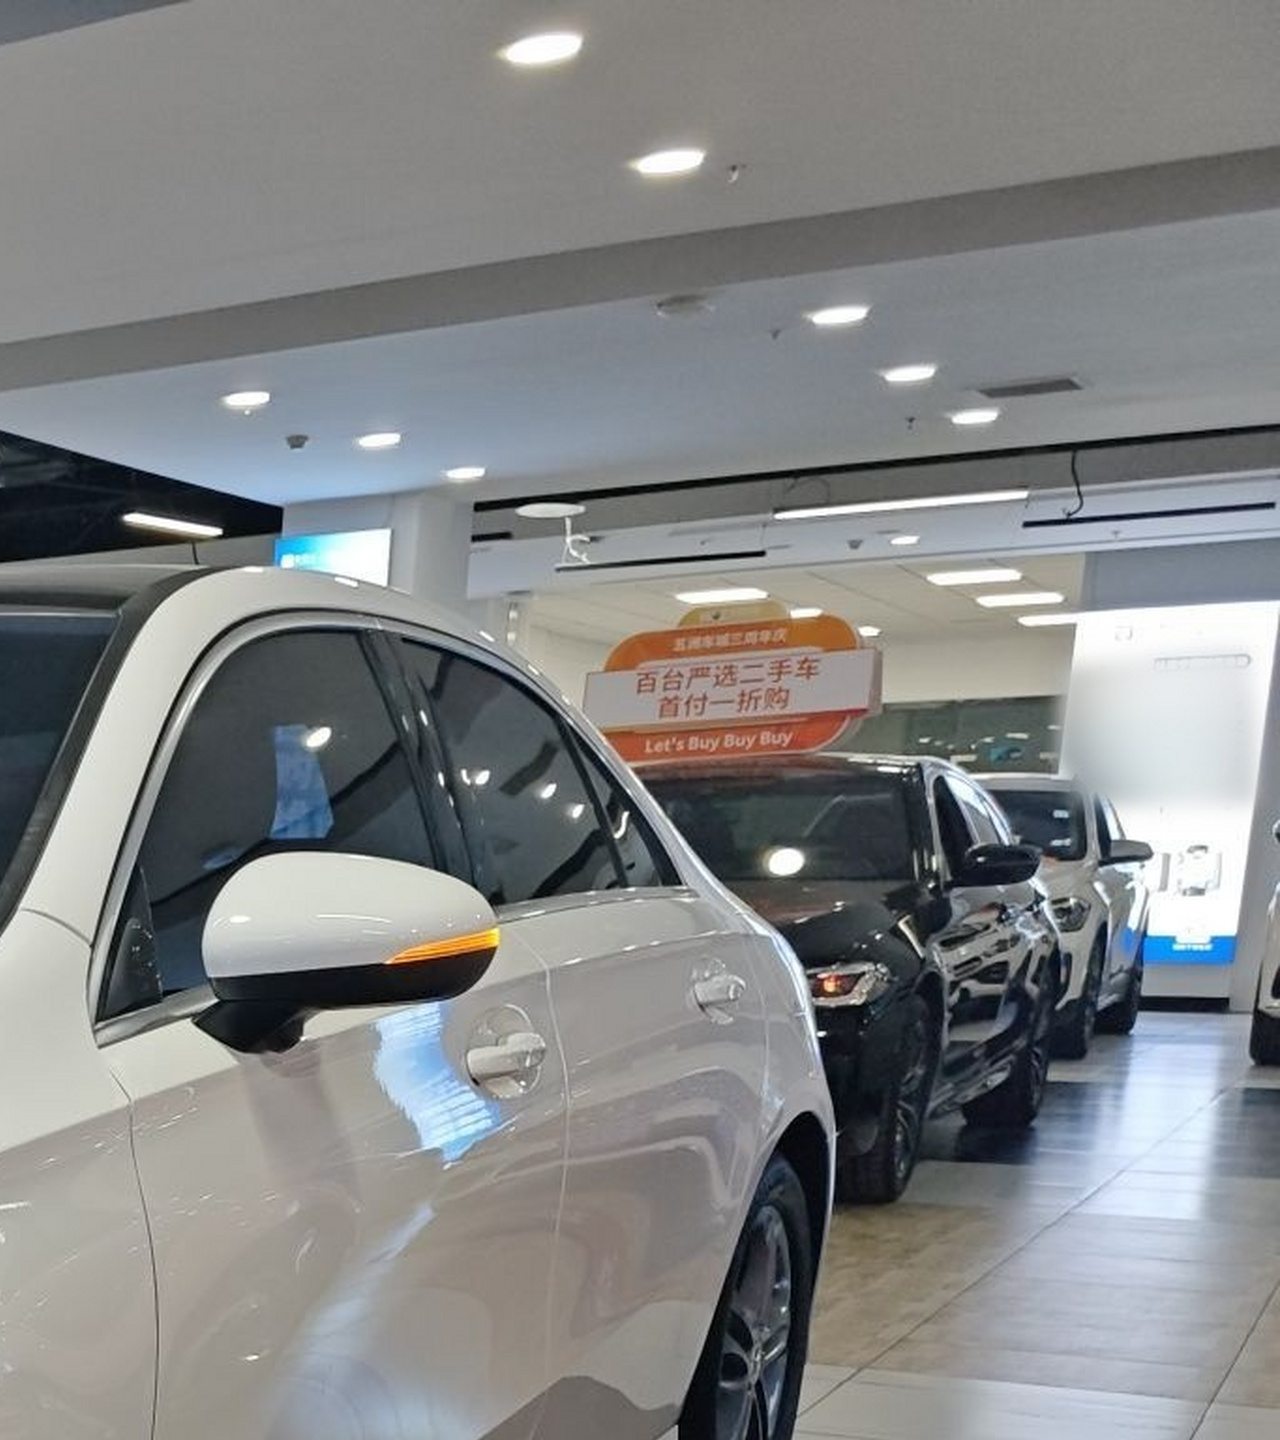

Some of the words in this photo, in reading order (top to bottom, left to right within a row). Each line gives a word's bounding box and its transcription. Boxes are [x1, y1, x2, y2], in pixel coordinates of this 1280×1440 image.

[636, 656, 820, 694] 百台严选二手车
[658, 687, 790, 719] 首付一折购
[645, 737, 684, 753] Let's
[688, 735, 721, 752] Buy
[724, 734, 756, 750] Buy
[760, 731, 793, 747] Buy
